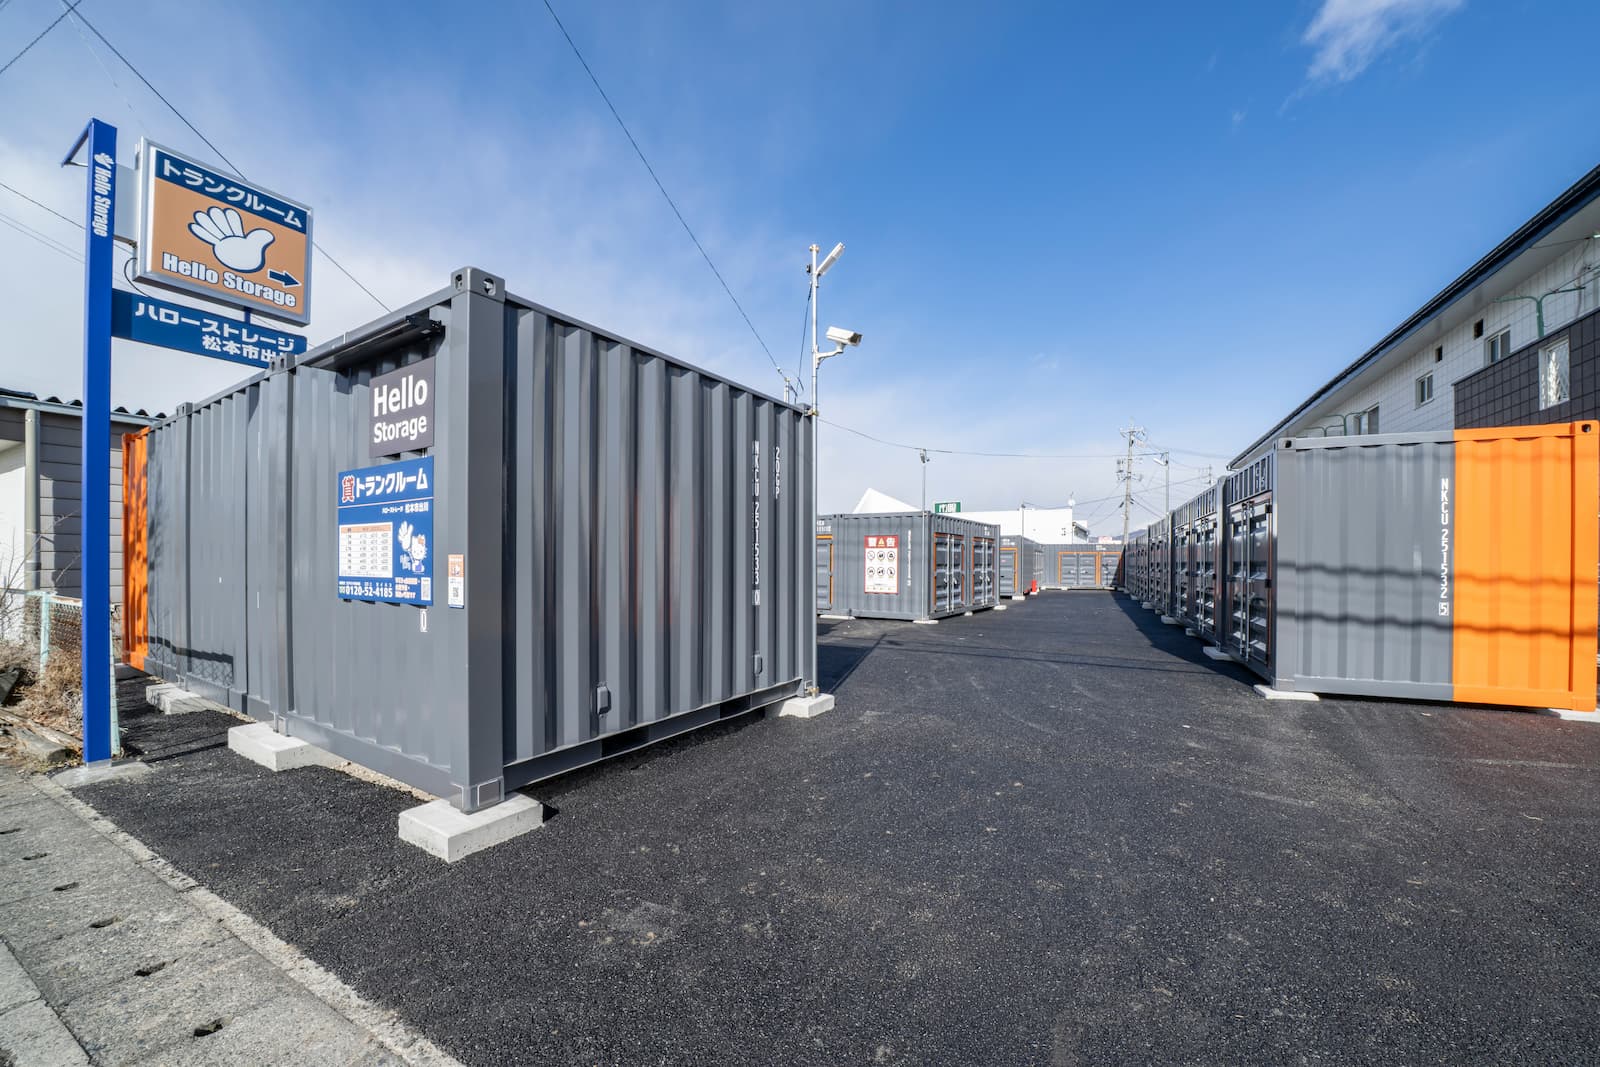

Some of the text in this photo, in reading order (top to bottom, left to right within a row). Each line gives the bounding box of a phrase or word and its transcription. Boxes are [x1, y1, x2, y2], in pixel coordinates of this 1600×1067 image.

[92, 166, 112, 237] Hello Storage
[163, 159, 303, 228] トランクルーム
[162, 252, 296, 308] Hello Storage
[135, 302, 295, 351] ハローストレージ
[202, 334, 283, 363] 松本市出
[374, 374, 428, 417] Hello
[374, 415, 427, 443] Storage
[1441, 478, 1449, 525] NKCU
[1440, 529, 1448, 599] 251532
